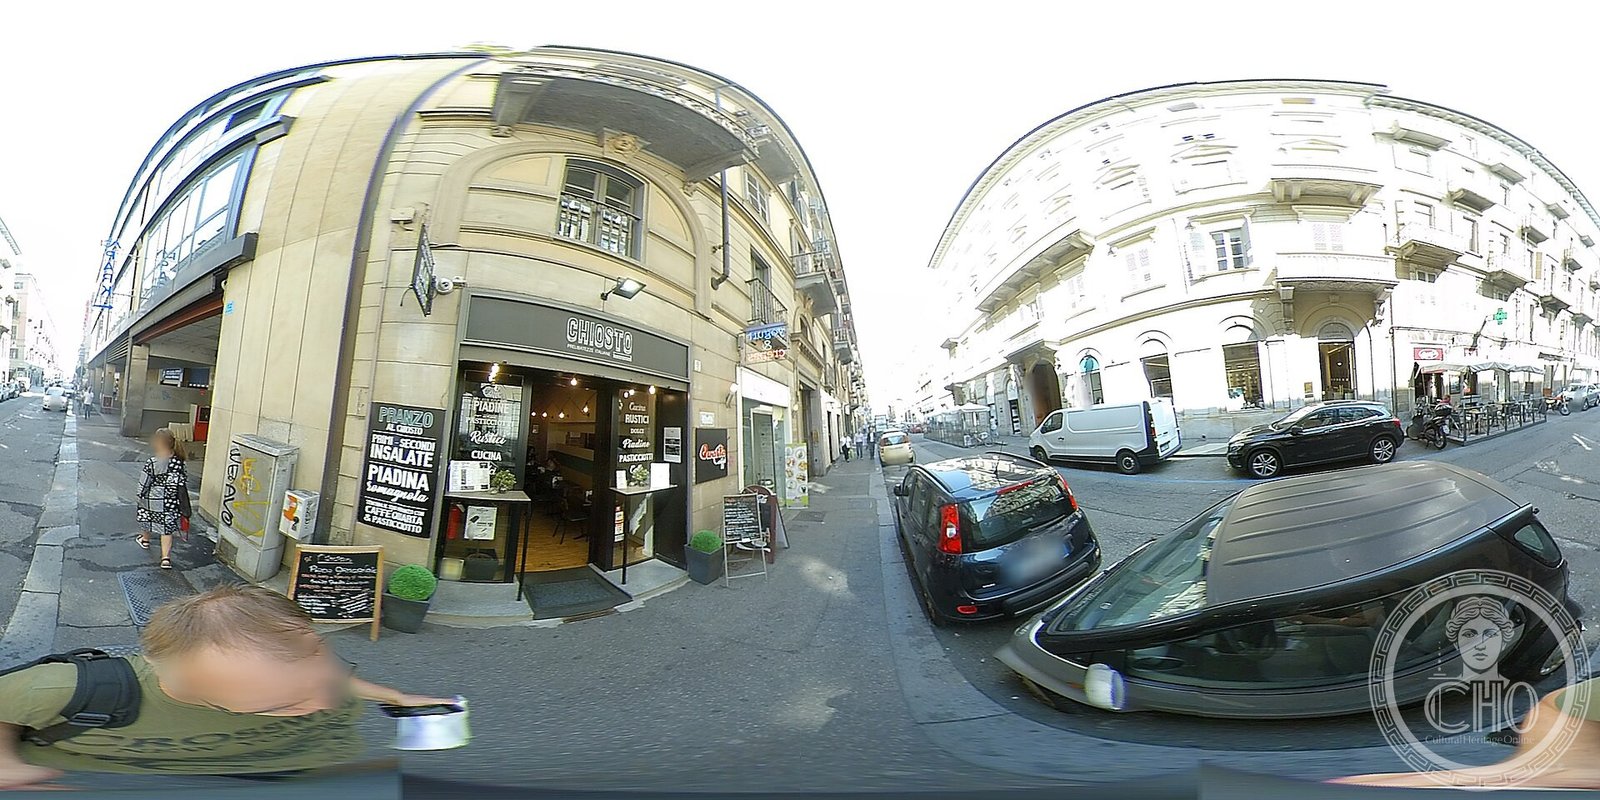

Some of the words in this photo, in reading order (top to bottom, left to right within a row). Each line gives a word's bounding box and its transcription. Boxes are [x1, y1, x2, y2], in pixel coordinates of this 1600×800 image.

[566, 317, 632, 354] CHIOSTO
[473, 401, 510, 413] PIADINE
[378, 406, 434, 428] PRANZO
[625, 414, 649, 424] RUSTICI
[386, 423, 395, 432] AL
[397, 425, 423, 435] CHIOSTO
[470, 430, 506, 444] Rustici
[372, 434, 393, 445] PRIMI
[400, 439, 435, 452] SECONDI
[370, 443, 434, 468] INSALATE
[471, 450, 502, 461] CUCINA
[367, 464, 429, 492] PIADINA
[364, 513, 371, 522] &
[372, 515, 422, 534] PASTICCIOTTO
